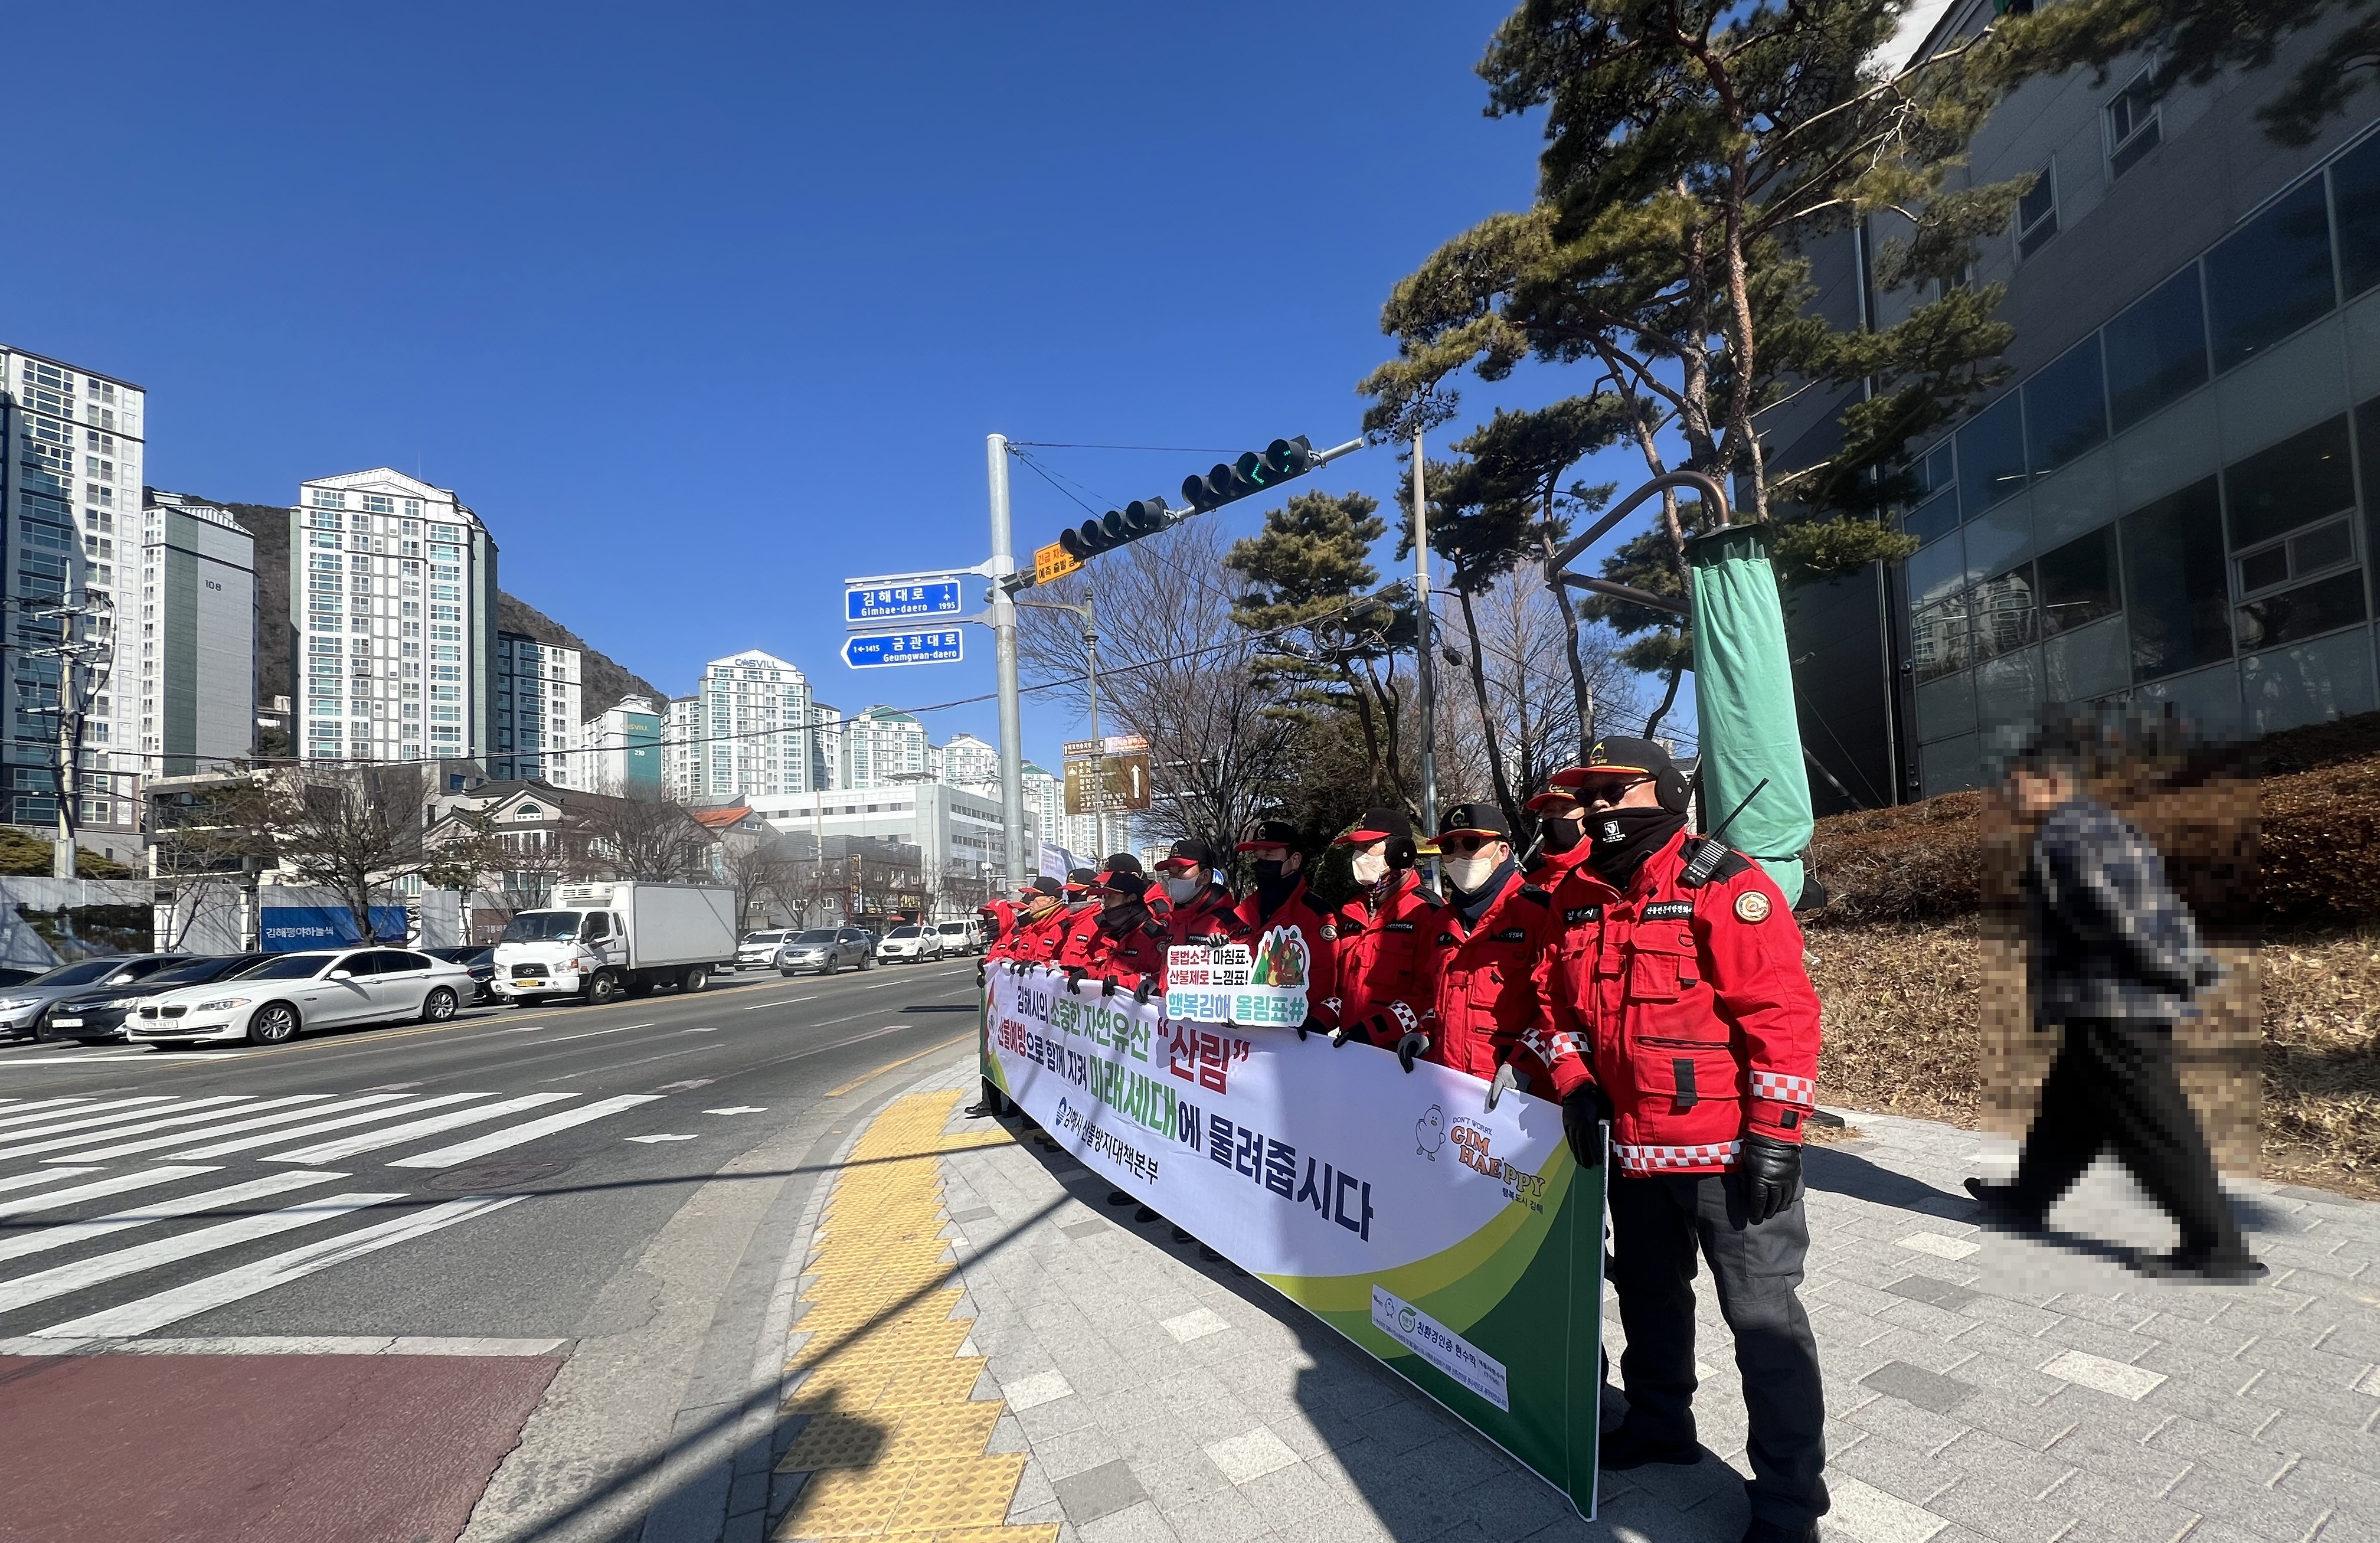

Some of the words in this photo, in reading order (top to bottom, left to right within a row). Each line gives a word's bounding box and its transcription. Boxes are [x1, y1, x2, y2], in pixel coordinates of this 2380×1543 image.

[1038, 552, 1050, 565] 긴급
[205, 580, 221, 591] 108
[863, 588, 925, 606] 김해대로
[861, 604, 927, 616] Gimhae-daero
[892, 633, 957, 651] 금관대로
[883, 650, 957, 662] Geumgwan-daero
[1170, 950, 1209, 965] 불법소각
[1214, 949, 1248, 965] 마침표.
[1169, 970, 1209, 985] 산불제로
[1212, 970, 1248, 986] 느낌표!
[1169, 992, 1231, 1019] 행복김해
[1236, 995, 1305, 1022] 올림표#
[1017, 985, 1049, 1024] 김해시의
[1051, 996, 1081, 1036] 소중한
[1083, 1004, 1151, 1063] 자연유산
[998, 1015, 1044, 1065] 산불예방으로
[1045, 1038, 1065, 1079] 함께
[1067, 1049, 1087, 1091] 지켜
[1089, 1054, 1201, 1152] 미래세대에
[1209, 1113, 1374, 1243] 물려줍시다
[1472, 1119, 1493, 1136] WORRY
[1064, 1105, 1084, 1137] 김해시
[1081, 1119, 1158, 1185] 산불방지대책본부
[1451, 1125, 1490, 1157] GIM
[1502, 1187, 1528, 1207] 행복도시
[1530, 1200, 1543, 1215] 김해
[1417, 1321, 1453, 1352] 친환경인증
[1455, 1343, 1476, 1368] 현수막
